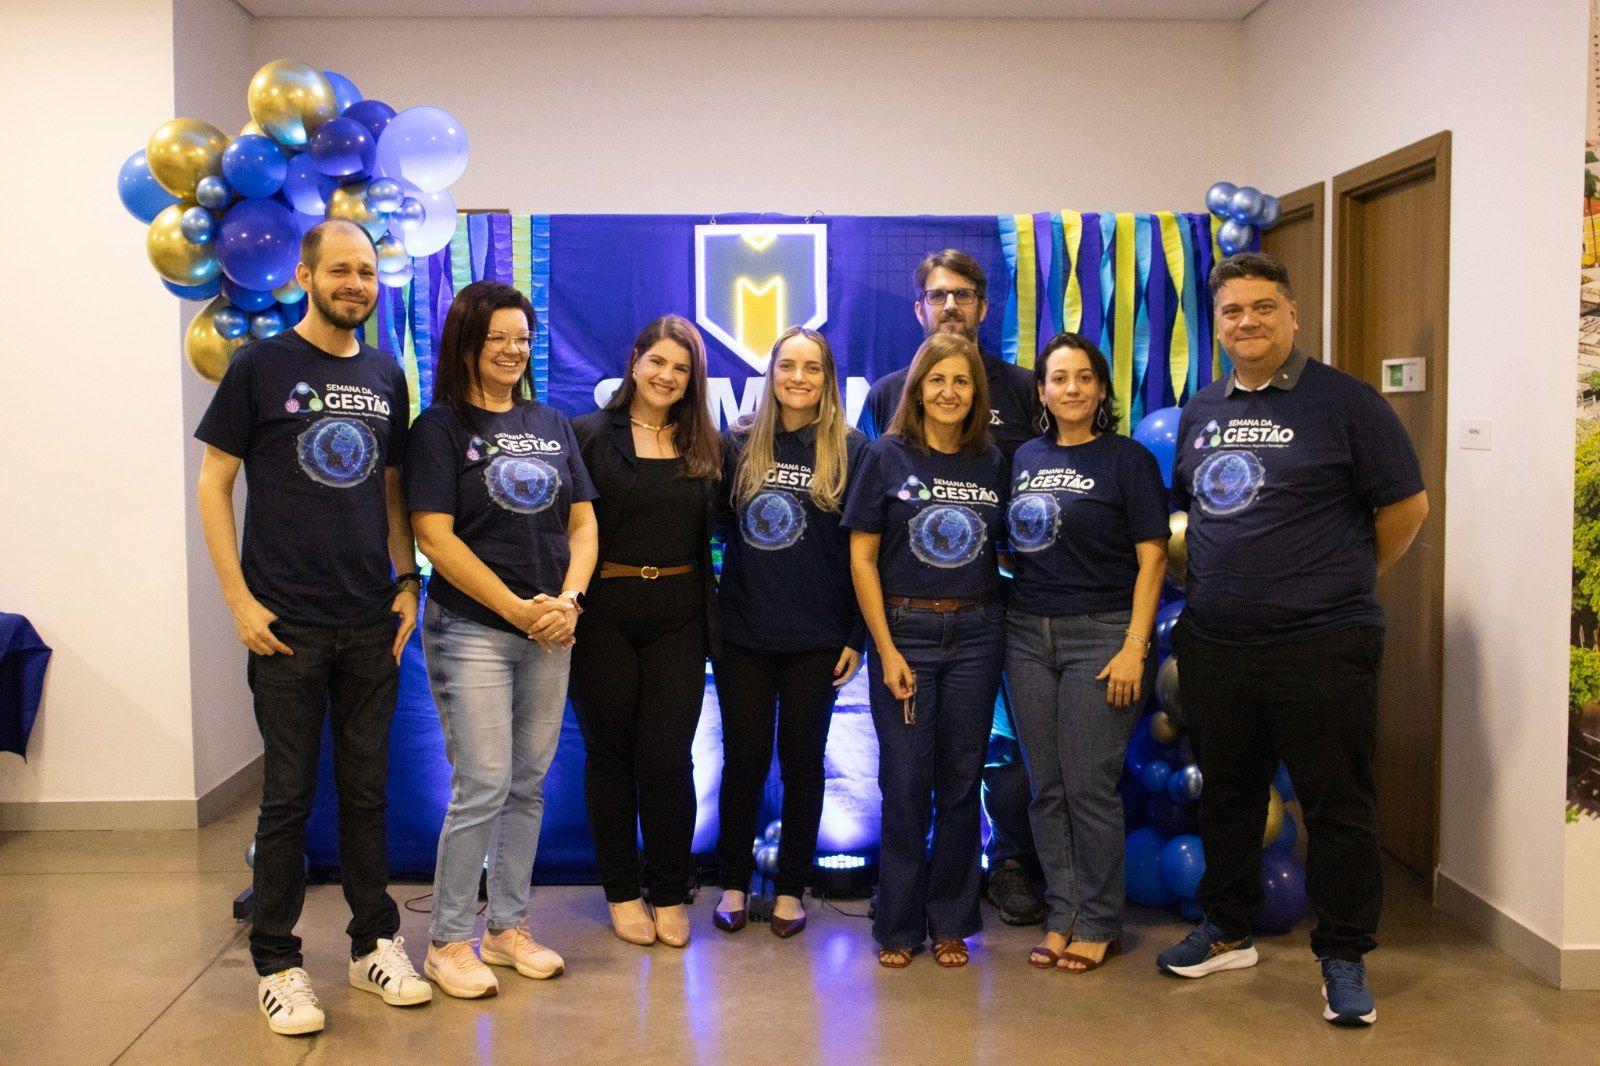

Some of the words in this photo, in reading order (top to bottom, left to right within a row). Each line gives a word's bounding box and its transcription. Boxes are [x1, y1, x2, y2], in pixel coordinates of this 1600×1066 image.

[326, 383, 361, 393] SEMANA
[361, 387, 373, 396] DA
[324, 392, 391, 416] GESTÃO
[1228, 419, 1260, 427] SEMANA
[1260, 419, 1273, 427] DA
[494, 432, 525, 440] SEMANA
[524, 432, 537, 440] DA
[1223, 425, 1294, 443] GESTÃO
[497, 437, 561, 453] GESTÃO
[768, 461, 799, 471] MANA
[800, 465, 811, 474] DA
[933, 477, 965, 489] SEMANA
[966, 481, 978, 489] DA
[1030, 474, 1095, 490] GESTÃO
[932, 485, 999, 503] GESTÃO
